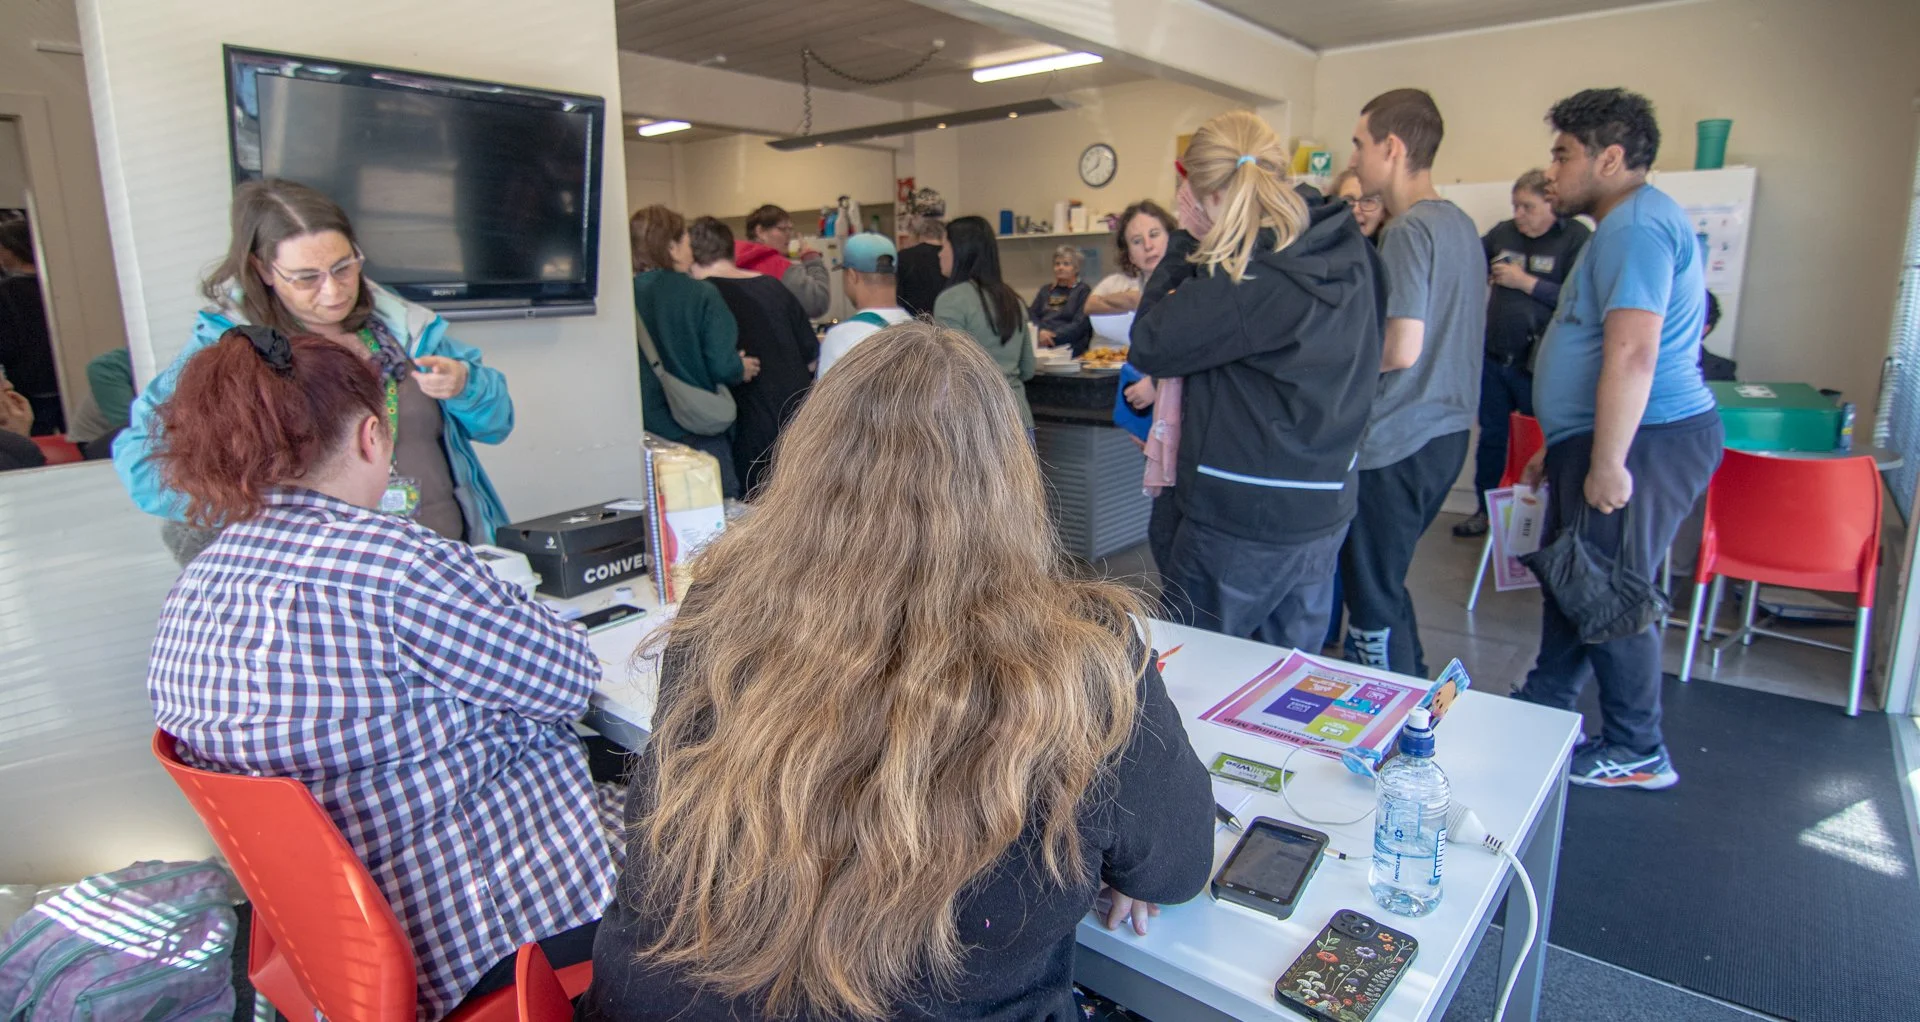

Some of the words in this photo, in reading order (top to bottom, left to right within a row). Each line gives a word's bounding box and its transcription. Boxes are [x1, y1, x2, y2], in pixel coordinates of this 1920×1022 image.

[583, 553, 648, 584] CONVE
[1223, 717, 1249, 729] Map
[1251, 725, 1300, 744] Building
